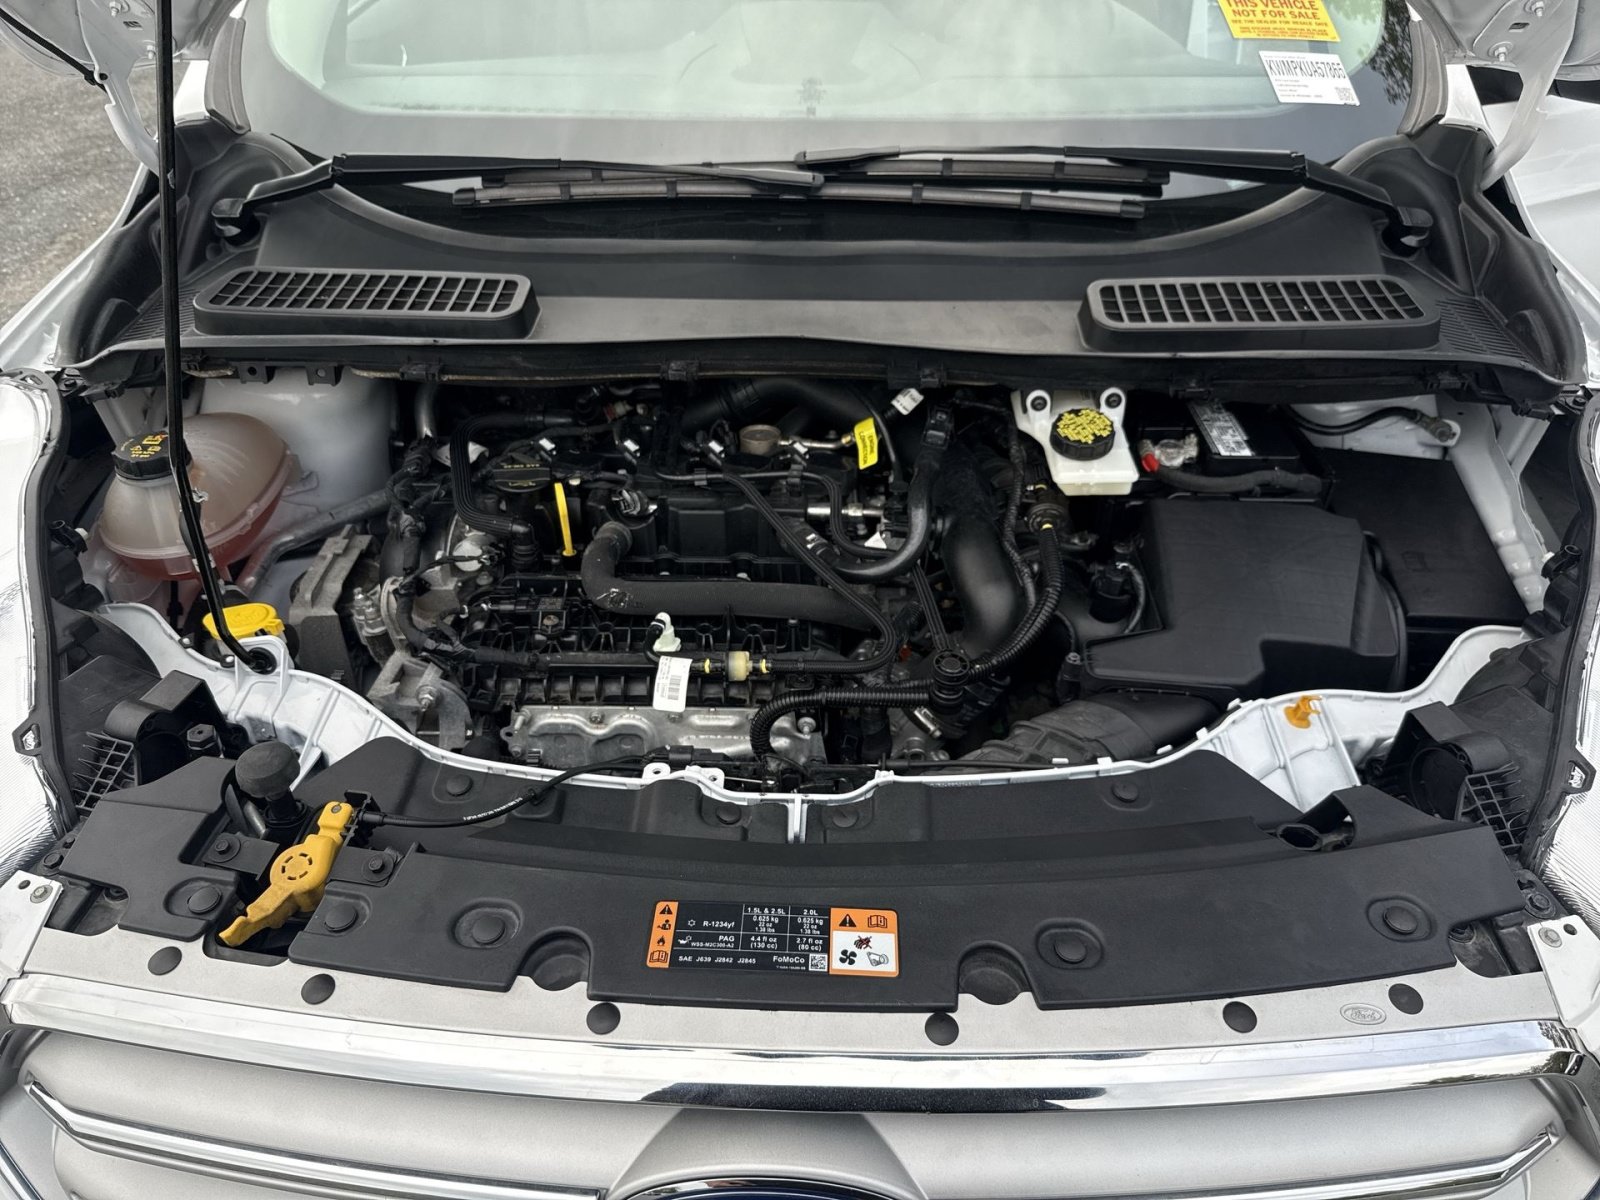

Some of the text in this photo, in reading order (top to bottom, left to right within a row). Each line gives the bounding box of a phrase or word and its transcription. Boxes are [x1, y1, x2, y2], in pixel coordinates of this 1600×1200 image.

[1226, 0, 1319, 10] THIS VEHICLE
[1232, 9, 1320, 20] NOT FOR SALE
[703, 920, 735, 929] R-1234yf
[815, 918, 824, 926] kg
[772, 955, 805, 964] FoMoCo
